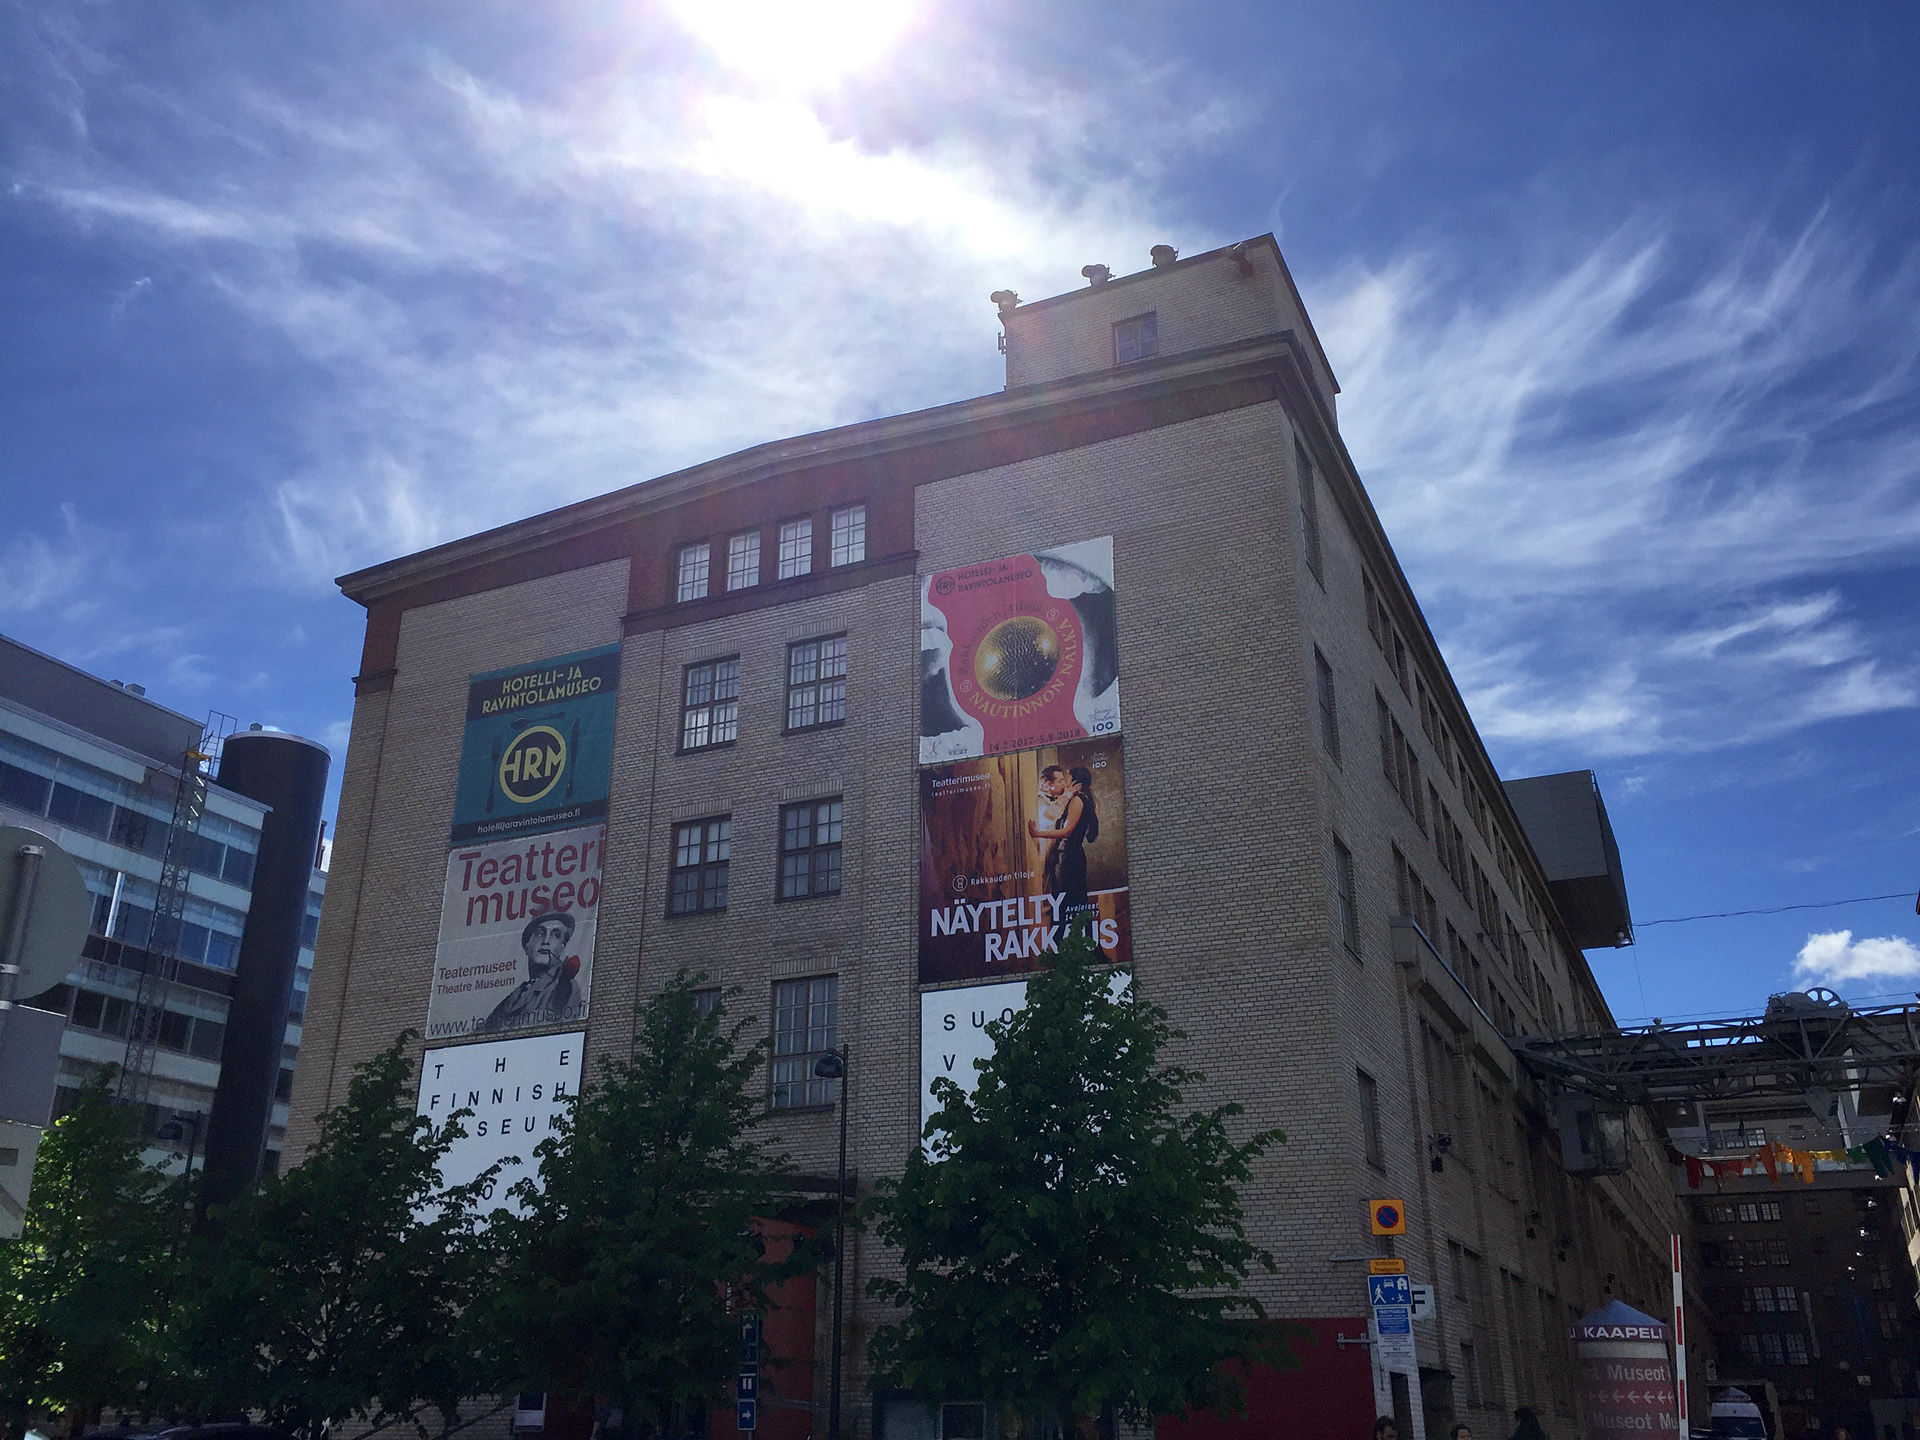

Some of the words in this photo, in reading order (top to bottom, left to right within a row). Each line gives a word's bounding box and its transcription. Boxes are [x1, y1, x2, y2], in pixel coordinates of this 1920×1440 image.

[1055, 617, 1078, 676] NÄLKÄ
[502, 671, 564, 694] HOTELLI-
[567, 665, 583, 680] JA
[482, 677, 601, 713] RAVINTOLAMUSEO
[969, 679, 1066, 719] NAUTINNON
[1092, 721, 1113, 732] 100
[502, 744, 563, 783] HRM
[1092, 761, 1107, 770] 100
[932, 772, 991, 788] Teatterimuseo
[459, 829, 605, 891] Teatteri
[970, 872, 1013, 886] Rakkauden
[1013, 870, 1035, 881] tiloja
[466, 877, 599, 926] museo
[931, 892, 1067, 937] NÄYTELTY
[439, 958, 517, 980] Teatermuseet
[437, 981, 472, 995] Theatre
[475, 976, 515, 990] Museum
[427, 1113, 564, 1141] MSEUM
[1411, 1290, 1426, 1314] F
[1584, 1327, 1663, 1339] KAAPELI
[1607, 1364, 1666, 1381] Museot
[1593, 1412, 1653, 1430] Museot
